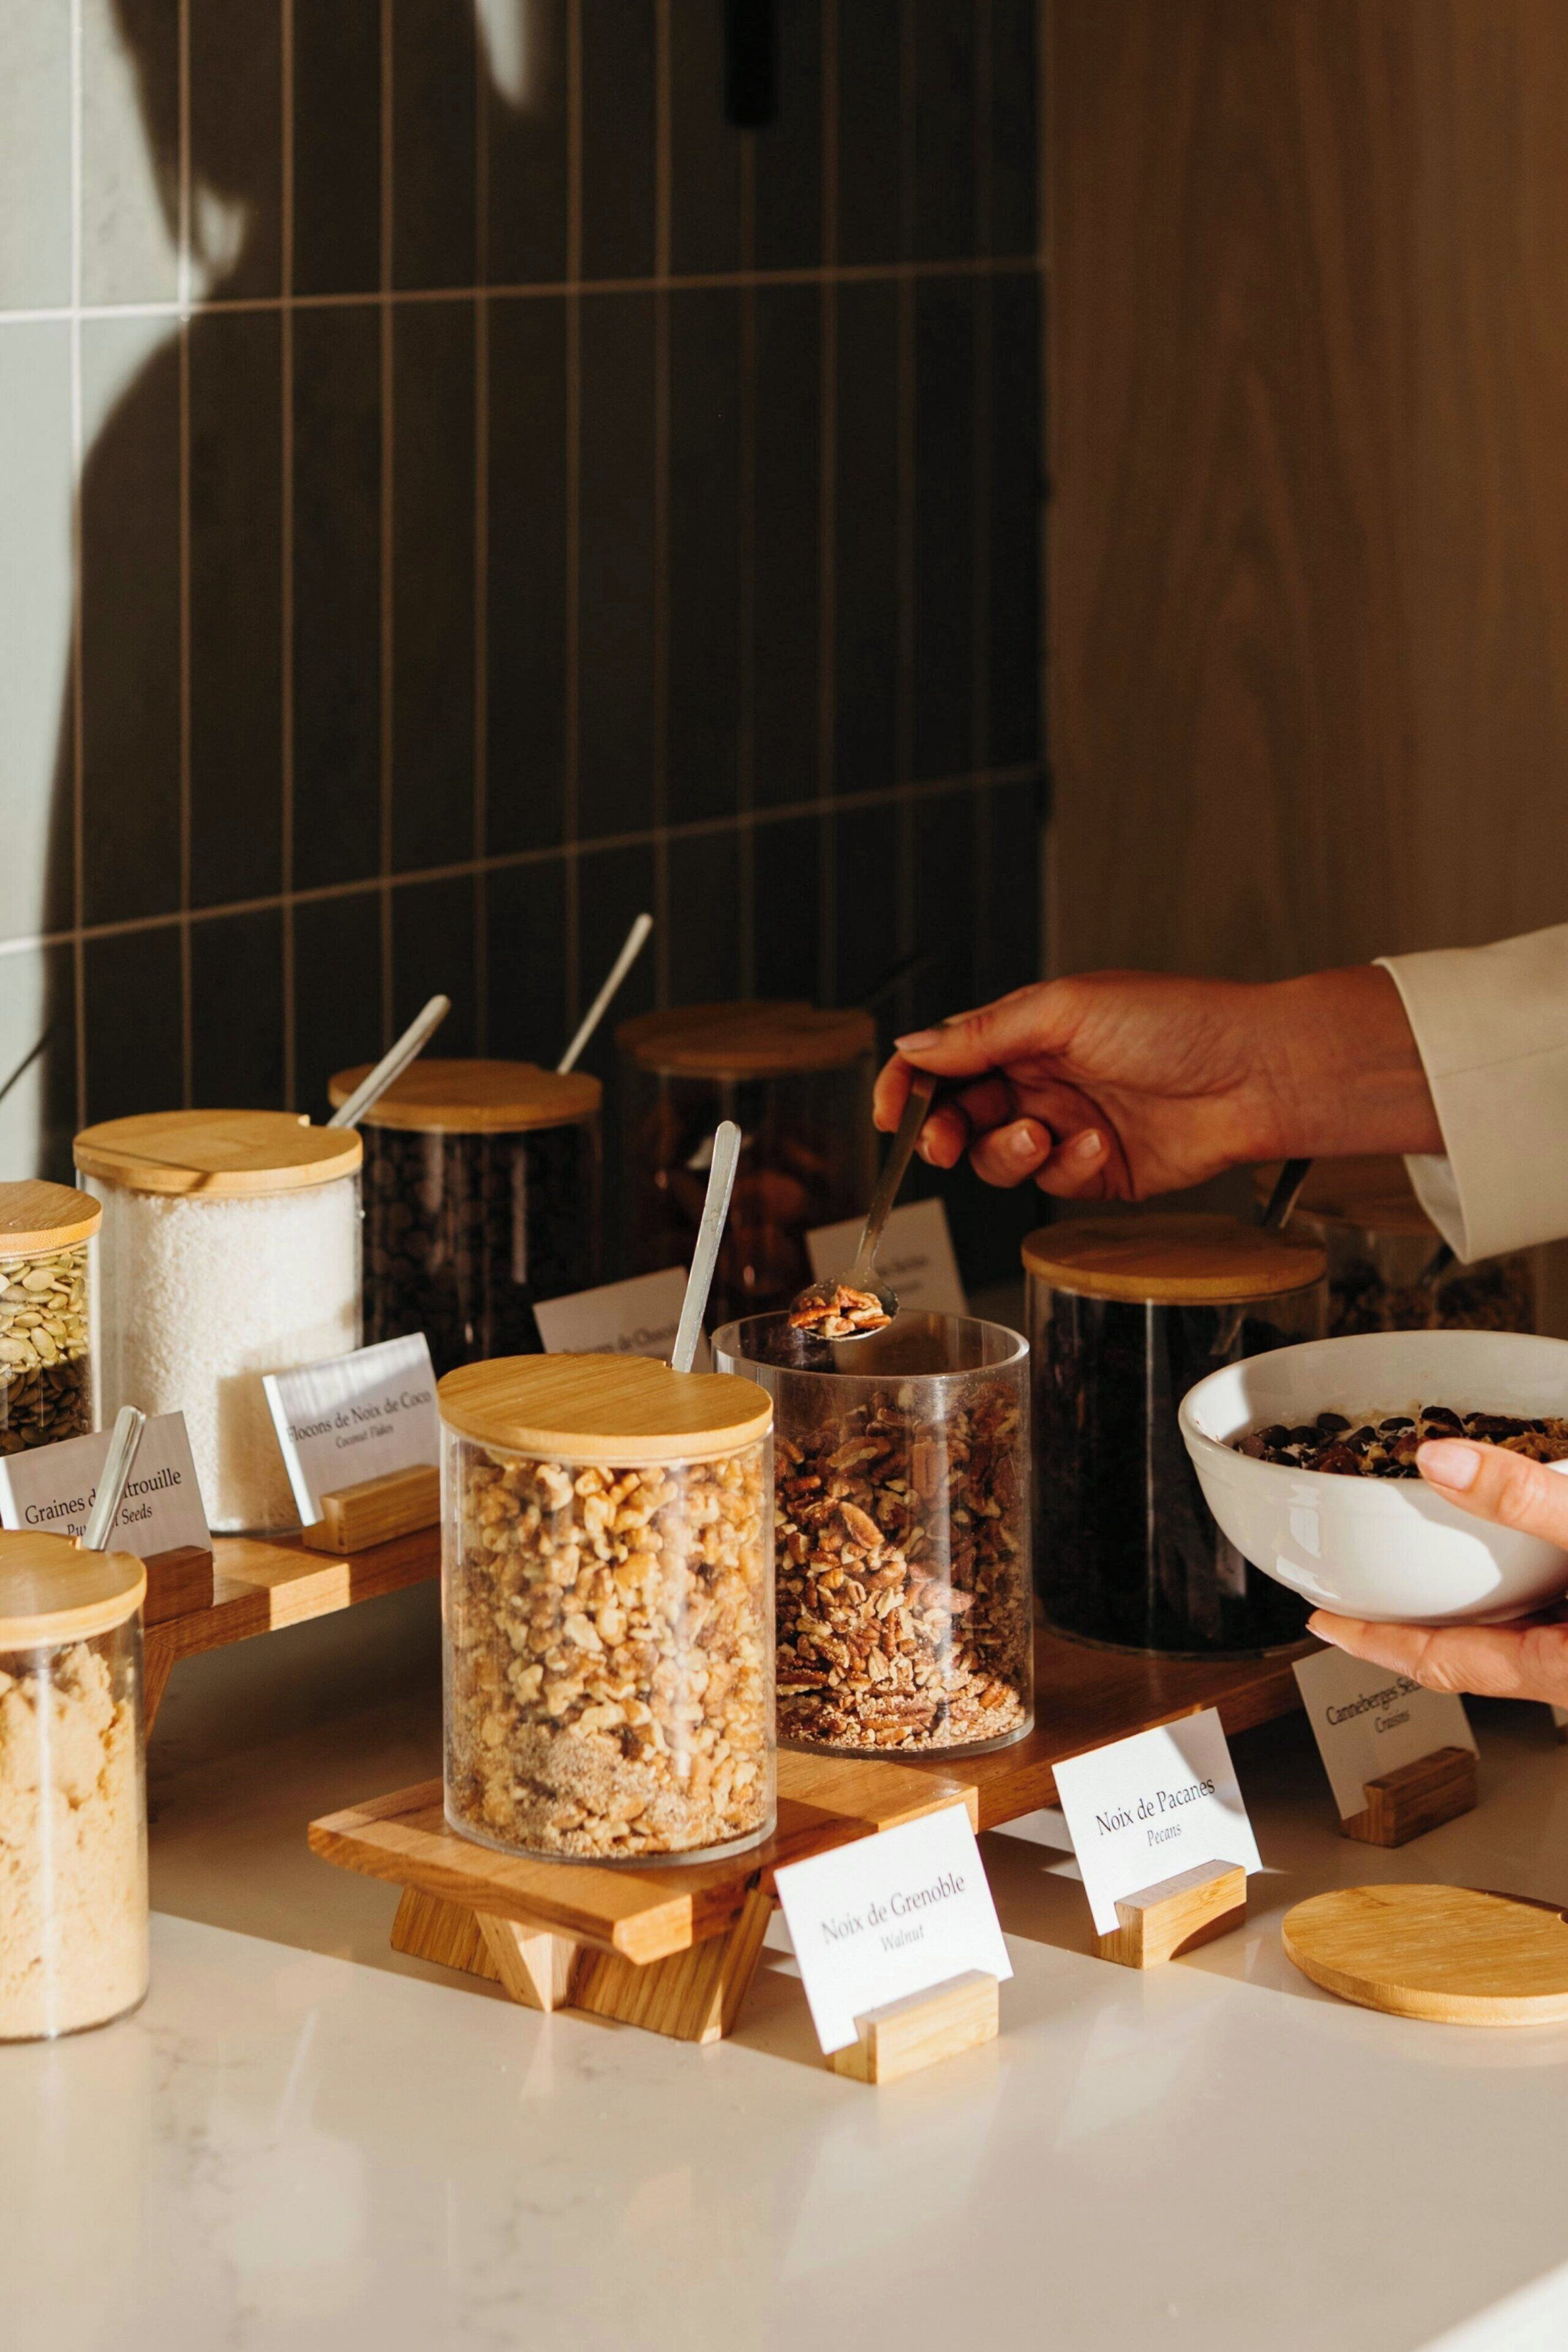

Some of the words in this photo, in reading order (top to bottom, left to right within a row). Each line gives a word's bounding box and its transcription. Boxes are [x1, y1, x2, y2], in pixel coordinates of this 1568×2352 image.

[334, 1411, 350, 1428] de
[350, 1404, 382, 1423] Noix
[383, 1396, 399, 1414] de
[400, 1390, 432, 1409] Coco
[25, 1498, 85, 1525] Graines
[121, 1503, 153, 1525] Seeds
[1096, 1806, 1134, 1836] Noix
[1137, 1797, 1155, 1820] de
[1156, 1779, 1215, 1812] Pacanes
[1147, 1823, 1182, 1847] Pecans
[821, 1912, 864, 1945] Noix
[867, 1902, 888, 1927] de
[891, 1872, 966, 1917] Grenoble
[881, 1924, 925, 1953] Walnut
